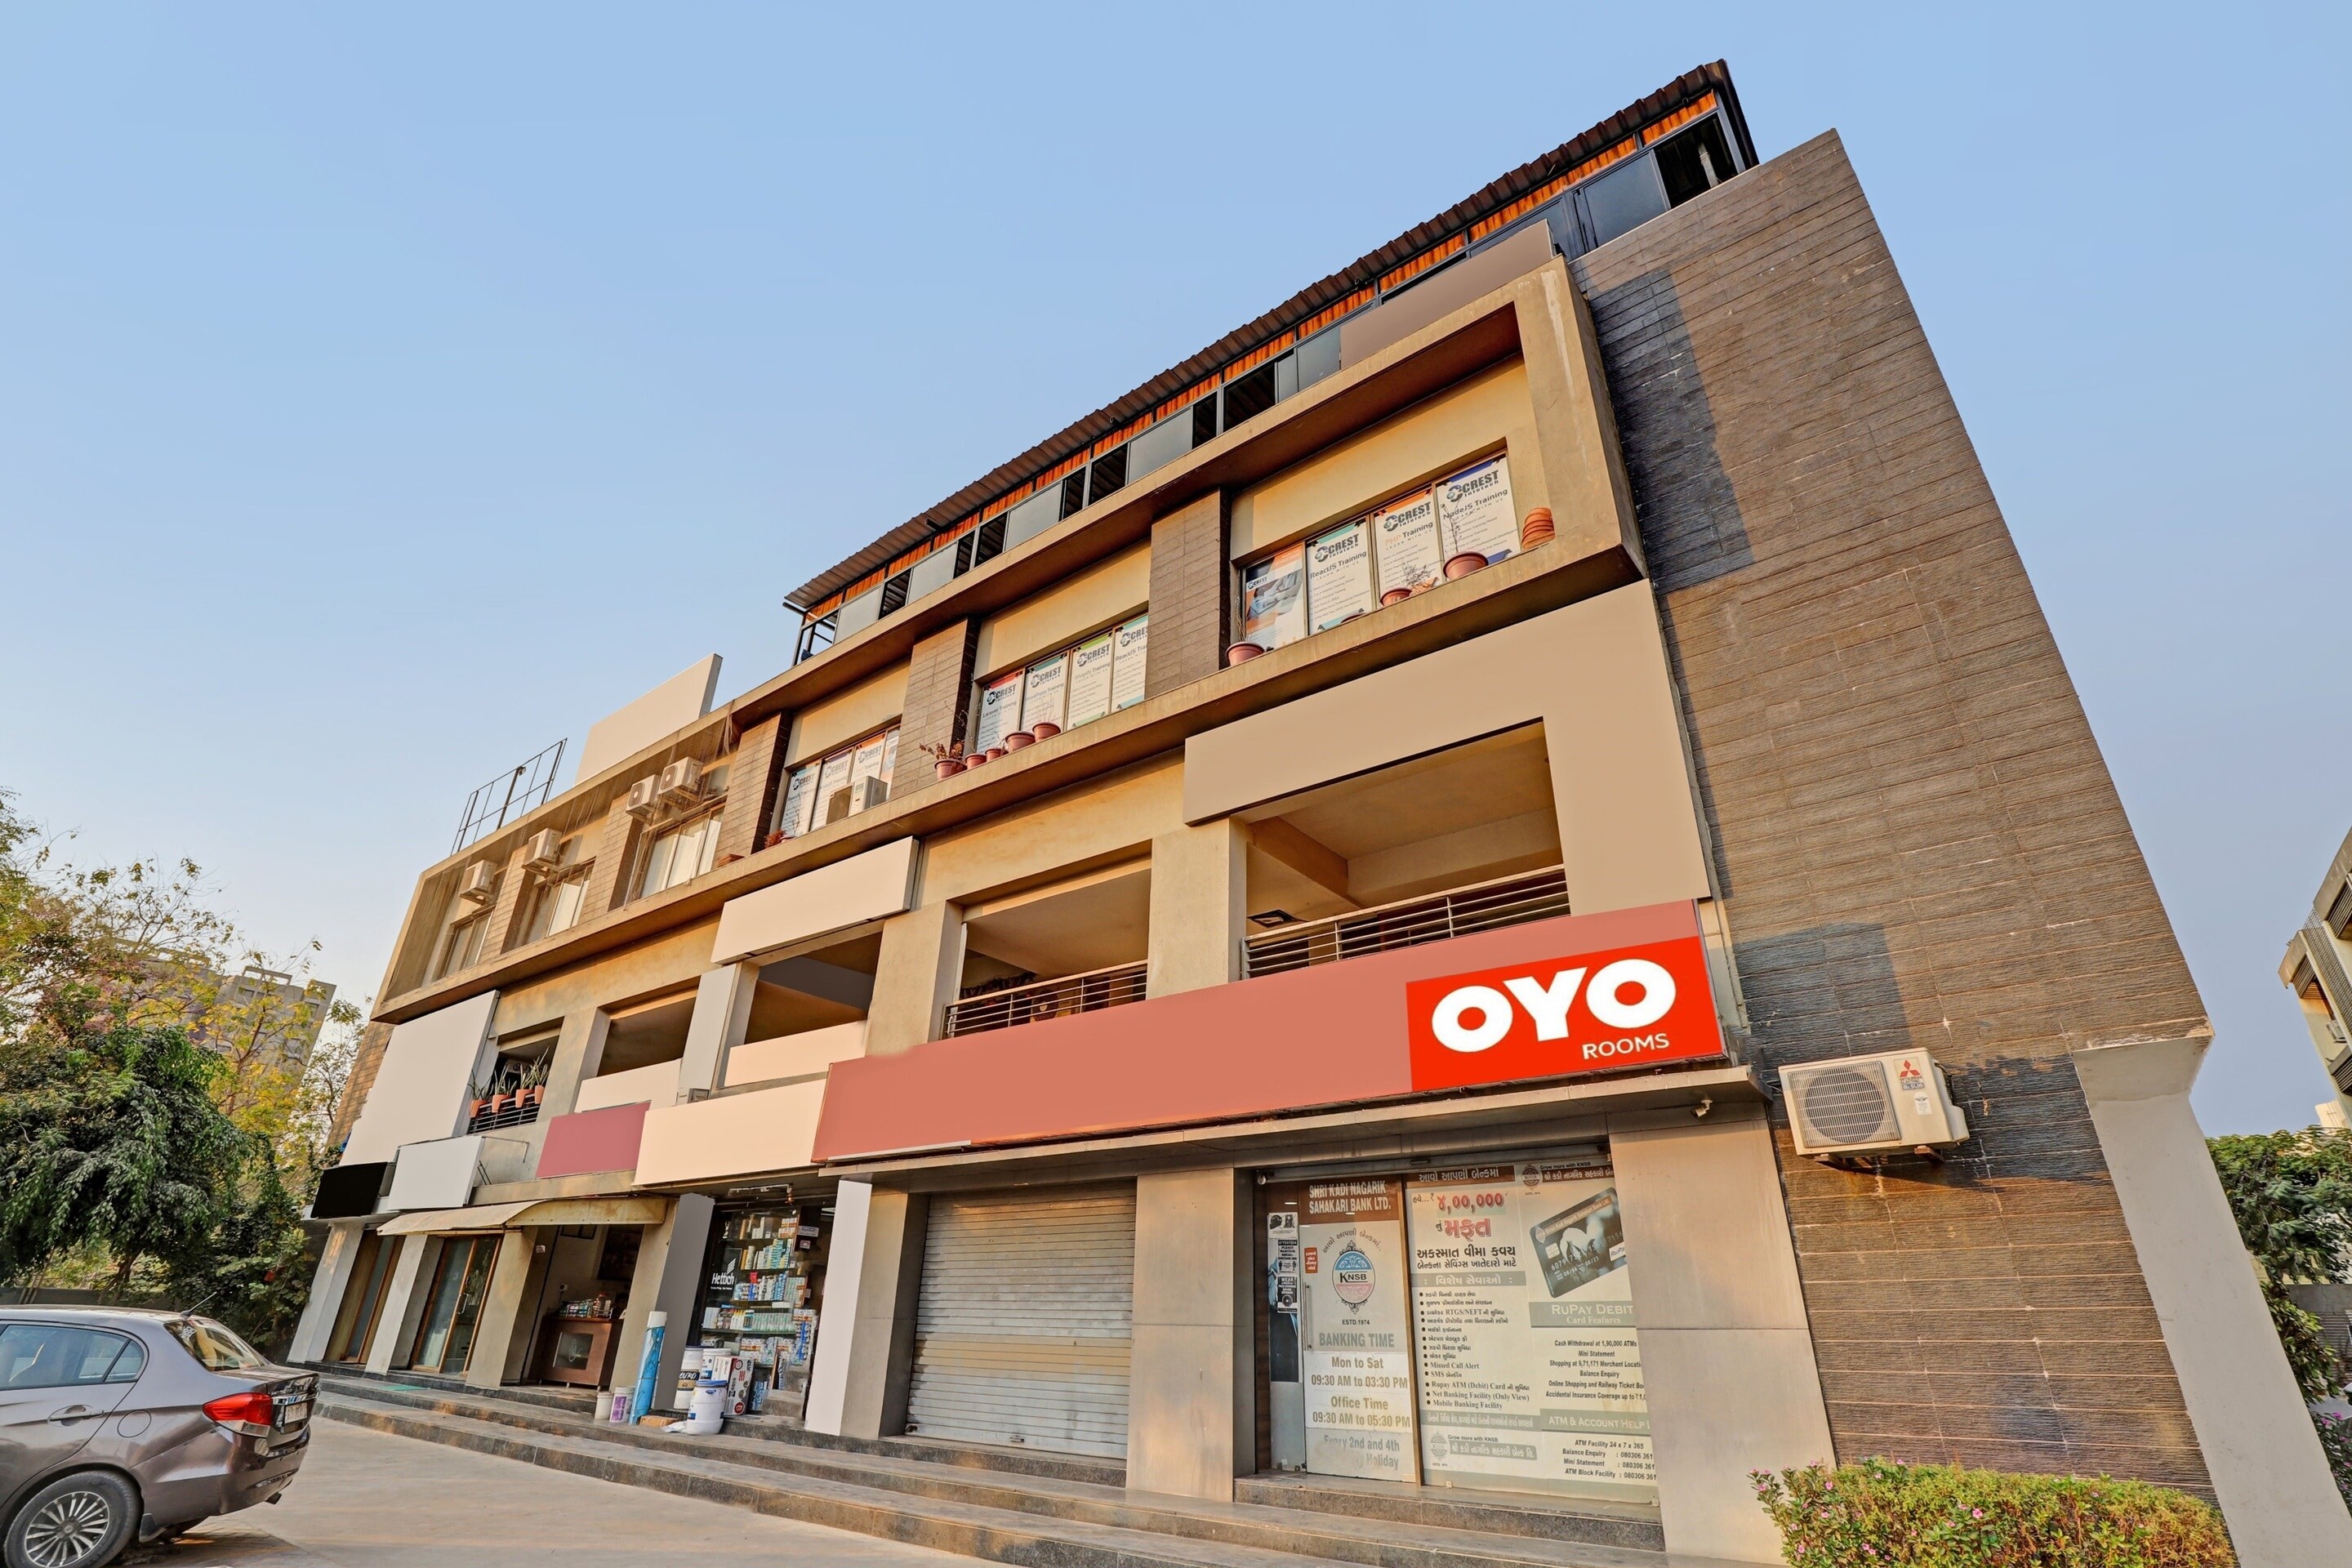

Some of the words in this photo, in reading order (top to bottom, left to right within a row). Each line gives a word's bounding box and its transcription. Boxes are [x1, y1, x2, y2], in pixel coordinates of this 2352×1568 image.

[1463, 470, 1499, 492] CREST
[1475, 489, 1508, 506] Training
[1397, 501, 1431, 522] CREST
[1385, 534, 1401, 546] PHP
[1402, 523, 1433, 538] Training
[1328, 533, 1359, 554] CREST
[1310, 564, 1337, 579] ReactJS
[1339, 550, 1367, 567] Training
[1087, 644, 1111, 661] CREST
[1040, 666, 1062, 681] CREST
[996, 684, 1017, 699] CREST
[1432, 959, 1677, 1053] OYO
[1582, 1032, 1670, 1060] ROOMS
[1419, 1172, 1438, 1183] આવો
[1309, 1184, 1327, 1198] SHRI
[1329, 1183, 1348, 1197] KADI
[1350, 1180, 1387, 1196] NAGARIK
[1309, 1198, 1348, 1214] SAHAKARI
[1350, 1197, 1373, 1212] BANK
[1374, 1196, 1392, 1210] LTD.
[1417, 1247, 1459, 1258] અકસ્માત
[1463, 1244, 1486, 1257] વીમા
[1490, 1246, 1516, 1256] કવચ
[1503, 1257, 1517, 1267] માટે
[711, 1272, 734, 1285] Hettich
[1340, 1272, 1367, 1283] KNSB
[1466, 1274, 1501, 1285] સેવાઓ
[1319, 1332, 1365, 1348] BANKING
[1368, 1333, 1395, 1348] TIME
[1331, 1356, 1352, 1369] Mon
[1355, 1357, 1364, 1369] to
[1367, 1356, 1384, 1369] Sat
[1311, 1374, 1334, 1386] 09:30
[1337, 1375, 1352, 1387] AM
[1354, 1376, 1363, 1387] to
[1365, 1376, 1390, 1388] 03:30
[1393, 1377, 1408, 1388] PM
[1601, 1370, 1620, 1379] Enquiry
[1468, 1382, 1489, 1390] (Debit)
[1565, 1380, 1587, 1388] Shopping
[1598, 1381, 1618, 1389] Railway
[1331, 1396, 1361, 1409] Office
[1363, 1397, 1388, 1410] Time
[1470, 1392, 1491, 1401] Facility
[1493, 1392, 1510, 1401] (Only
[1512, 1394, 1530, 1402] View)
[1597, 1392, 1620, 1401] Coverage
[1454, 1401, 1479, 1409] Banking
[1480, 1401, 1503, 1410] Facility
[1312, 1411, 1337, 1423] 09:30
[1339, 1414, 1353, 1425] AM
[1356, 1414, 1365, 1425] to
[1367, 1414, 1392, 1427] 05:30
[1395, 1416, 1410, 1428] PM
[1548, 1416, 1568, 1425] ATM
[1570, 1417, 1577, 1426] &
[1579, 1418, 1619, 1428] ACCOUNT
[1621, 1419, 1646, 1429] HELP
[1349, 1437, 1365, 1449] 2nd
[1367, 1438, 1383, 1450] and
[1386, 1440, 1400, 1452] 4th
[1588, 1440, 1609, 1448] Facility
[1585, 1450, 1606, 1458] Enquiry
[1366, 1453, 1399, 1470] Holiday
[1595, 1470, 1616, 1479] Facility
